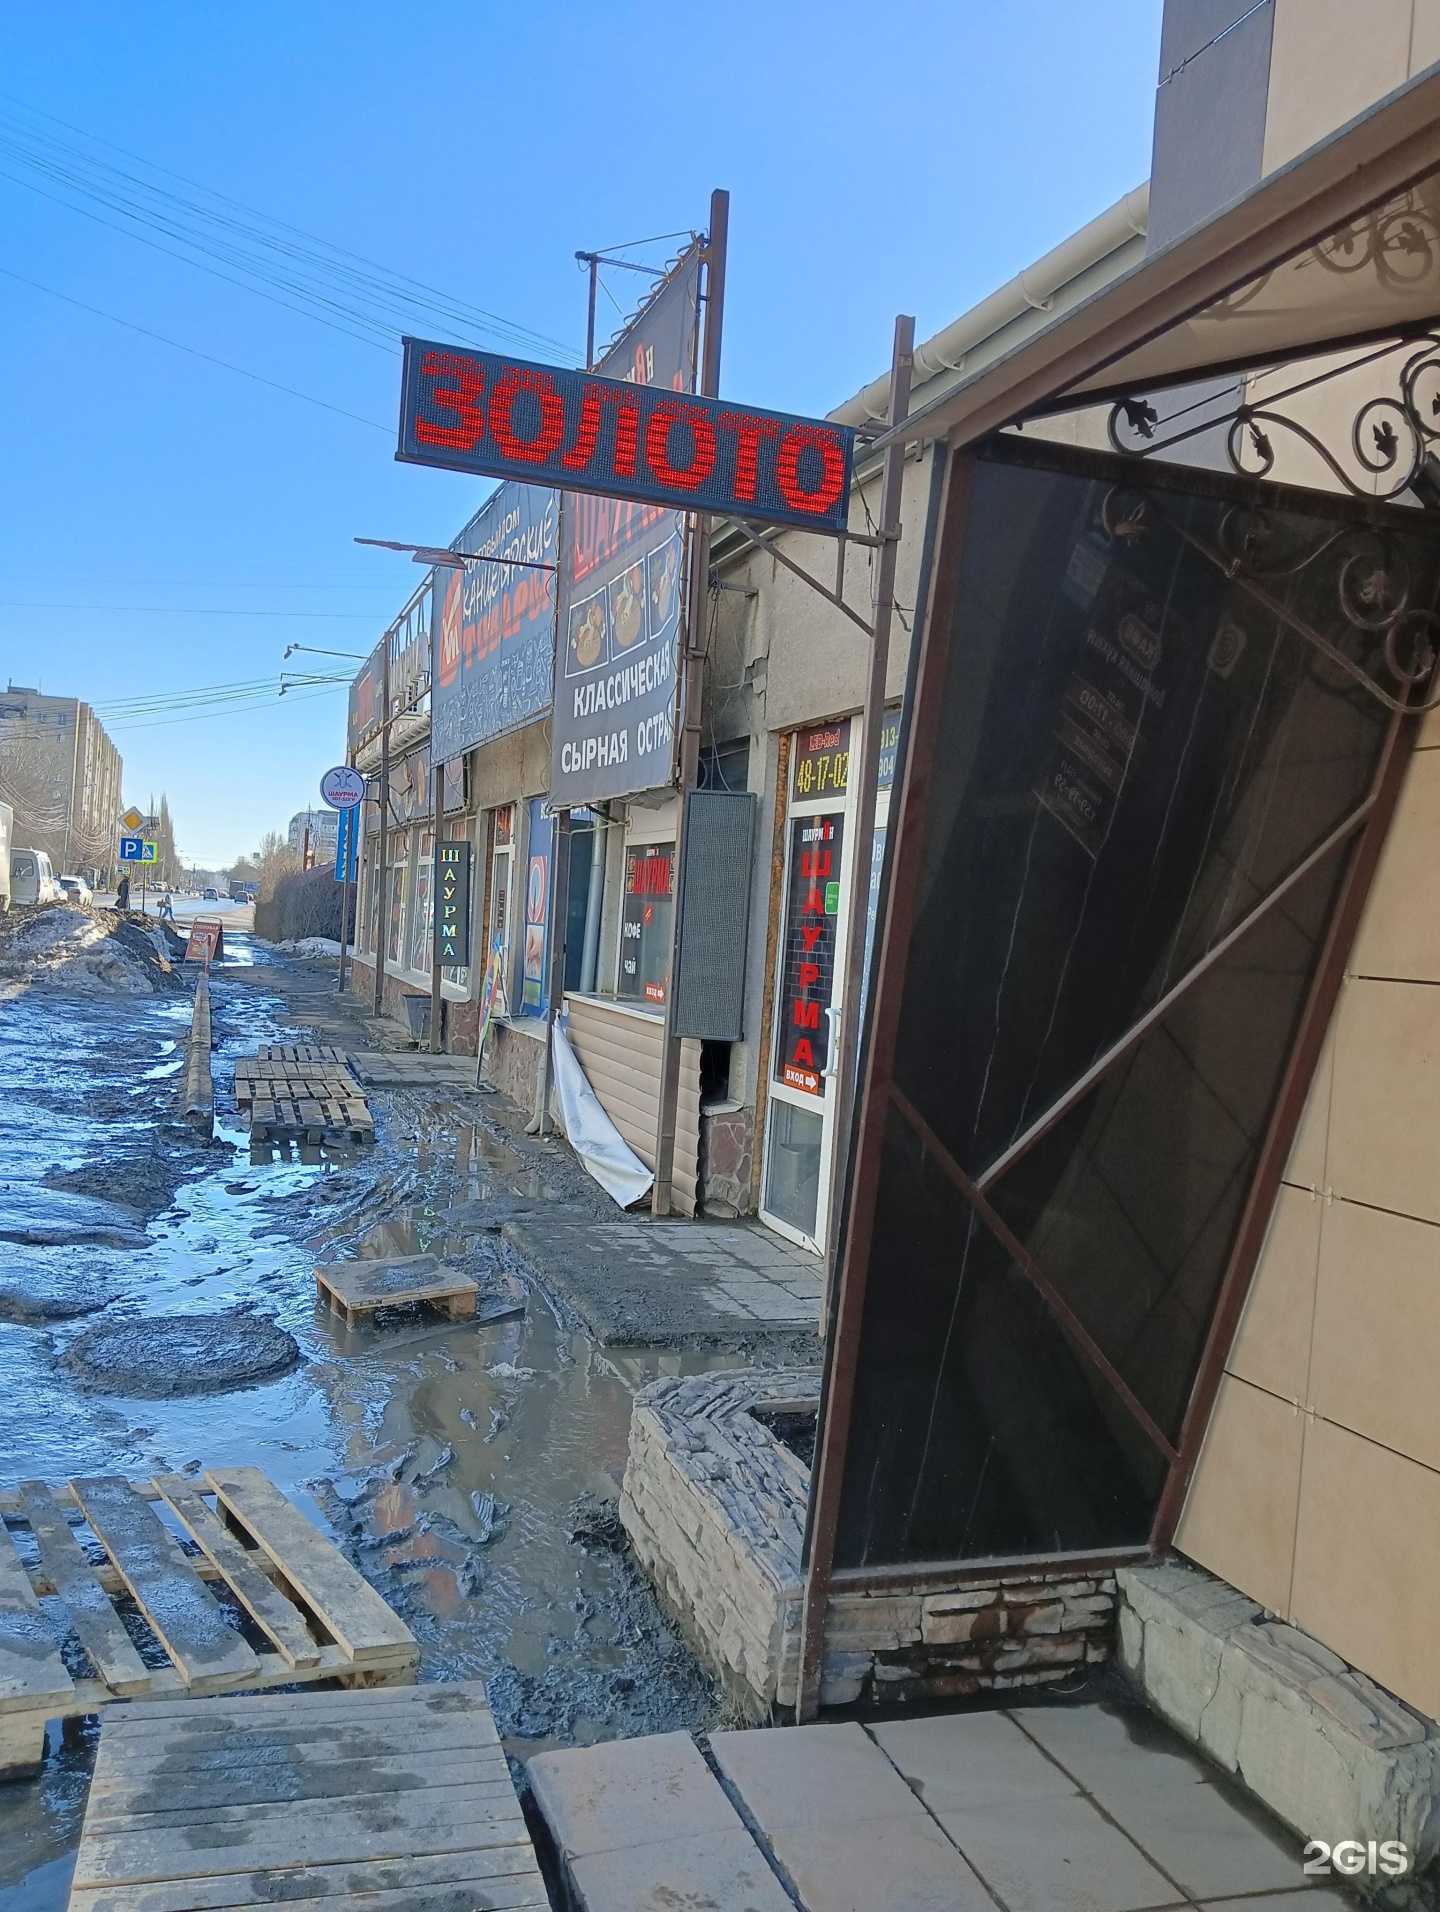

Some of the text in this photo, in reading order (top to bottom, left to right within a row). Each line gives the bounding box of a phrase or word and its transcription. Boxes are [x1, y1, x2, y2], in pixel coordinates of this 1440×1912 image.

[415, 351, 846, 514] ЗОЛОТО
[573, 640, 671, 718] КЛАССИЧЕСКАЯ
[561, 729, 628, 773] СЫРНАЯ
[797, 752, 849, 794] 48-17-02
[441, 849, 460, 956] ШАУРМА
[624, 922, 641, 939] КОФЕ
[792, 849, 833, 1067] ШАУРМА
[785, 1069, 805, 1087] ВХОД
